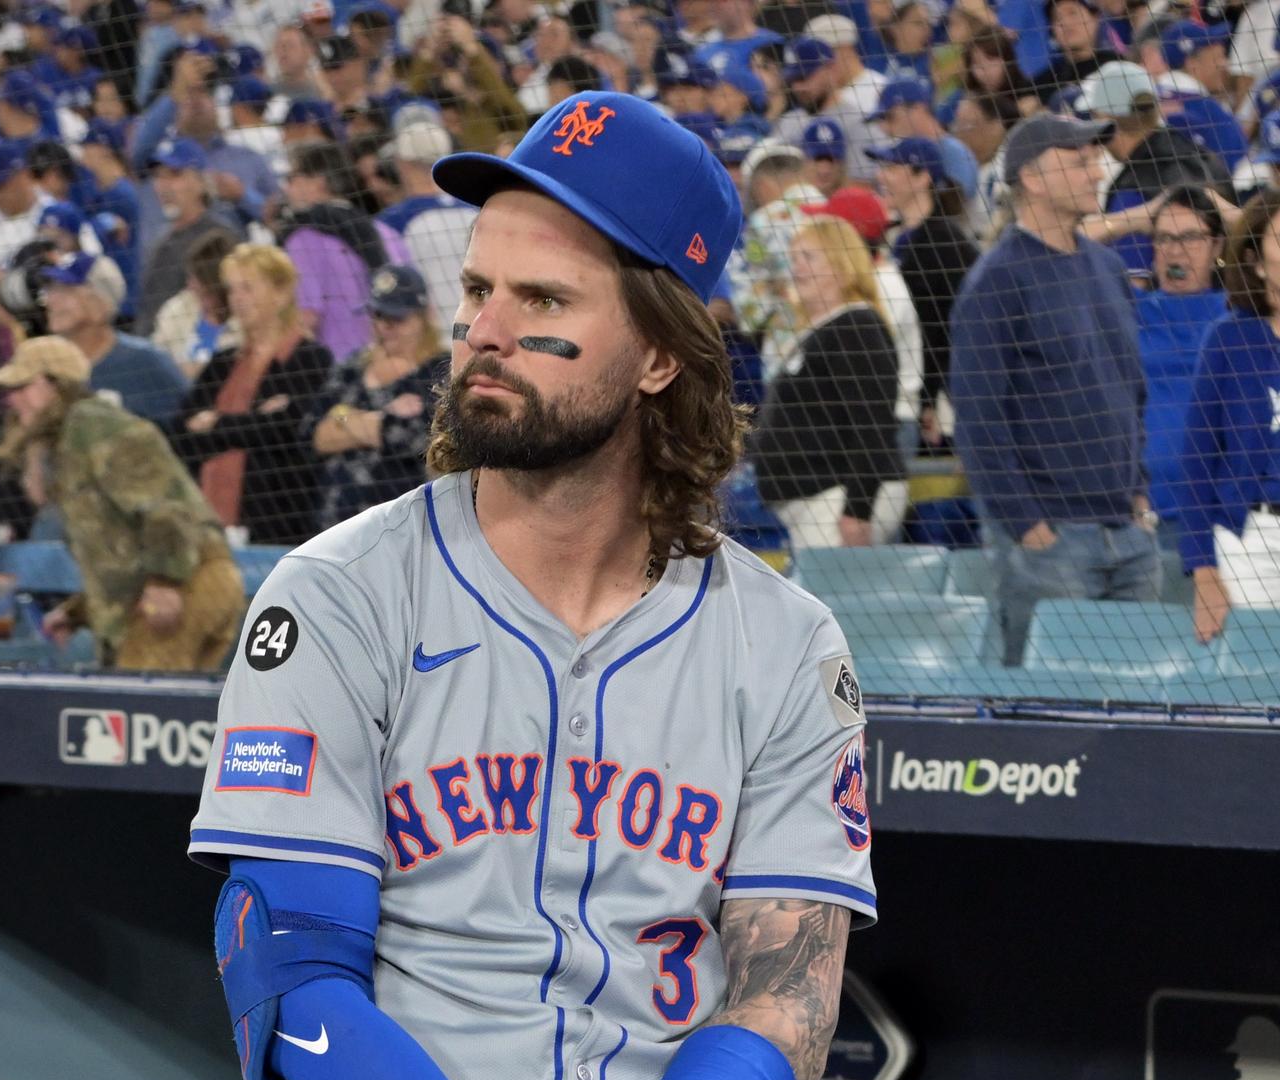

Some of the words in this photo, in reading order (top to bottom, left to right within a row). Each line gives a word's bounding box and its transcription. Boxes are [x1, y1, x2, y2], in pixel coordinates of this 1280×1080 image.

[250, 620, 290, 658] 24
[130, 713, 218, 767] POS
[234, 741, 286, 759] NewYork-
[231, 757, 302, 778] Presbyterian
[889, 750, 1081, 804] loanDepot
[385, 752, 544, 872] NEW
[566, 756, 725, 884] YOR
[635, 916, 709, 1026] 3
